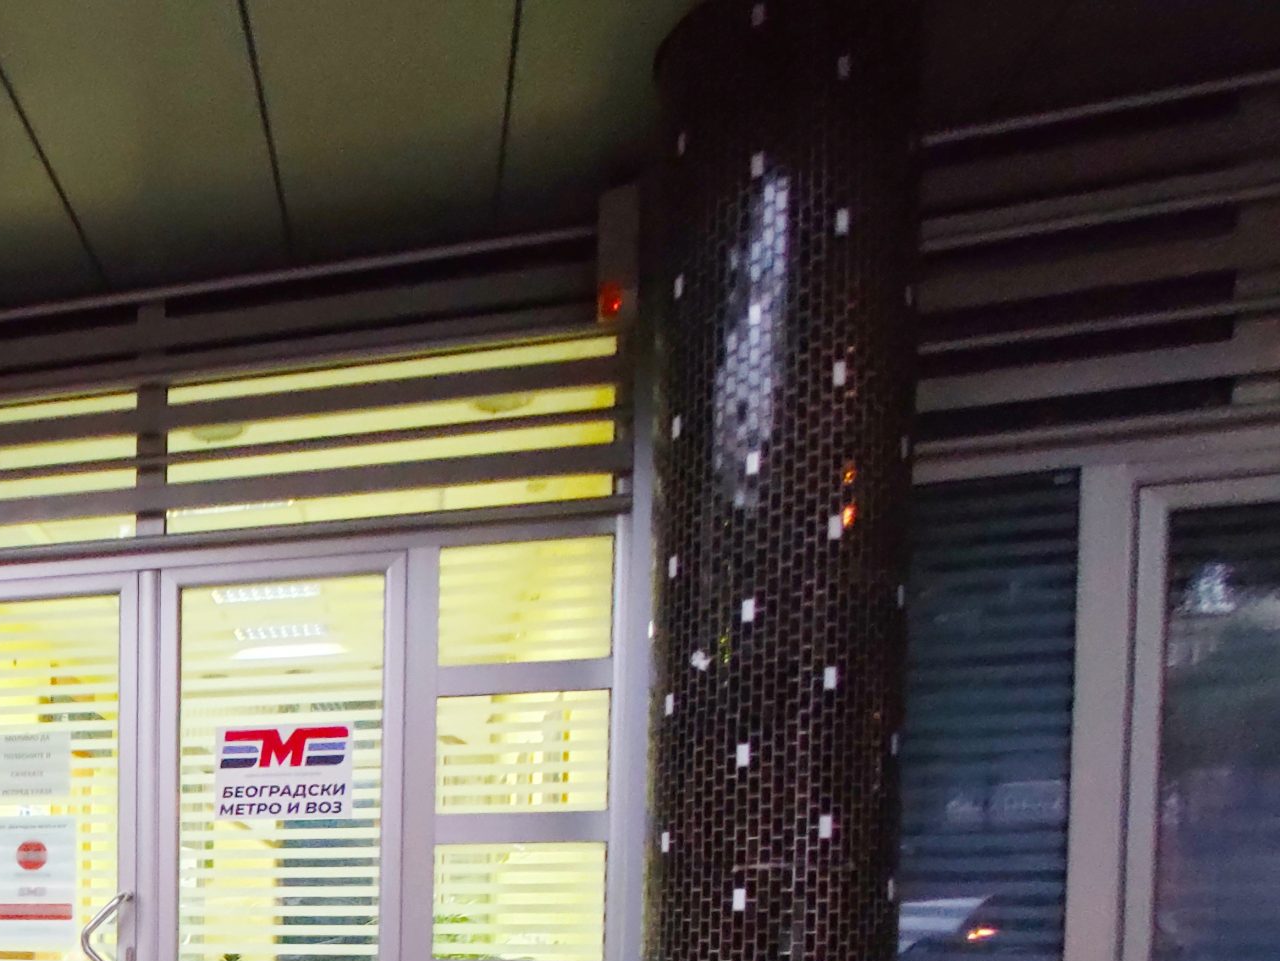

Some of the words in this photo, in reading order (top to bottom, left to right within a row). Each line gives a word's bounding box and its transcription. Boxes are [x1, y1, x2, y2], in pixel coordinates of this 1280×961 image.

[222, 783, 346, 799] БЕОГРАДСКИ
[219, 802, 282, 816] МЕТРО
[287, 802, 300, 815] И
[305, 801, 343, 815] ВОЗ
